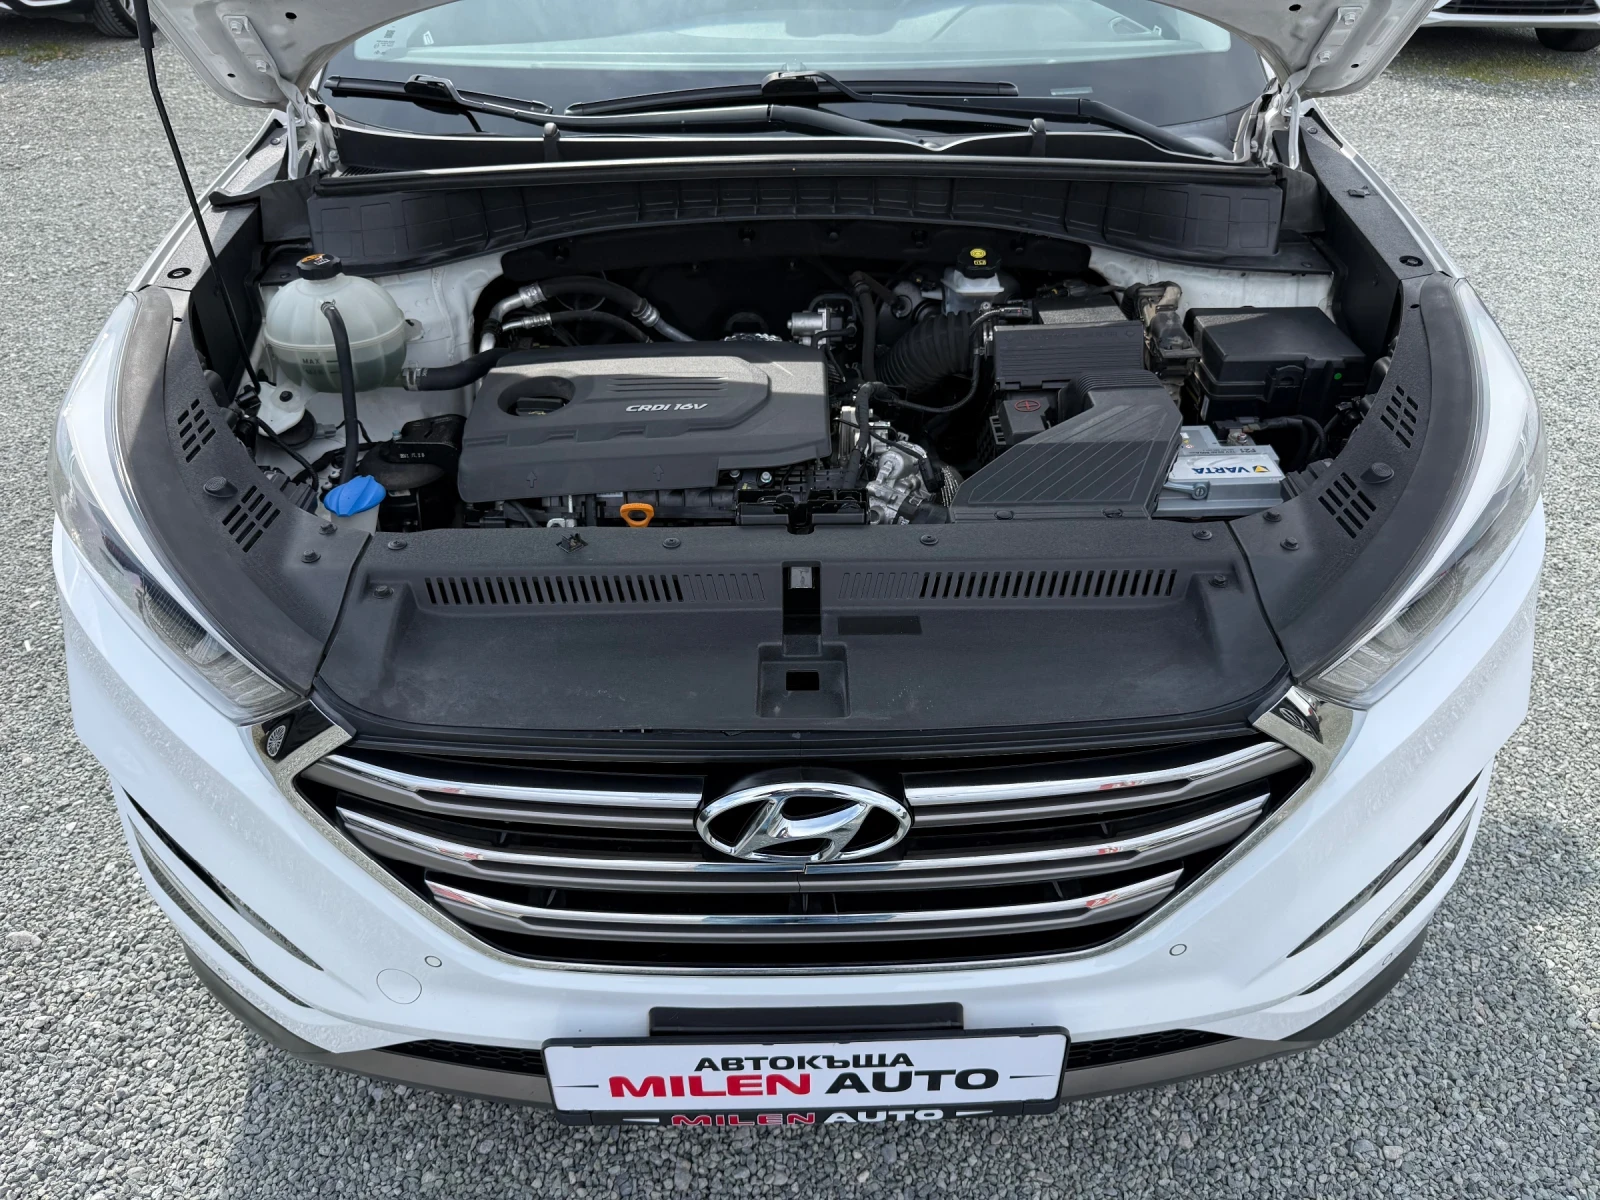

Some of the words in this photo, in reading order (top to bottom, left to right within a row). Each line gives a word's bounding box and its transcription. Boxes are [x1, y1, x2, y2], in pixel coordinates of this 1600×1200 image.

[625, 404, 672, 412] CRDI
[673, 403, 708, 411] 16V
[1192, 466, 1250, 474] VARTA
[694, 1053, 914, 1071] АВТОКЪЩА
[608, 1073, 811, 1098] MILEN
[824, 1068, 999, 1094] AUTO
[671, 1112, 816, 1126] MILEN
[823, 1109, 944, 1123] AUTO
